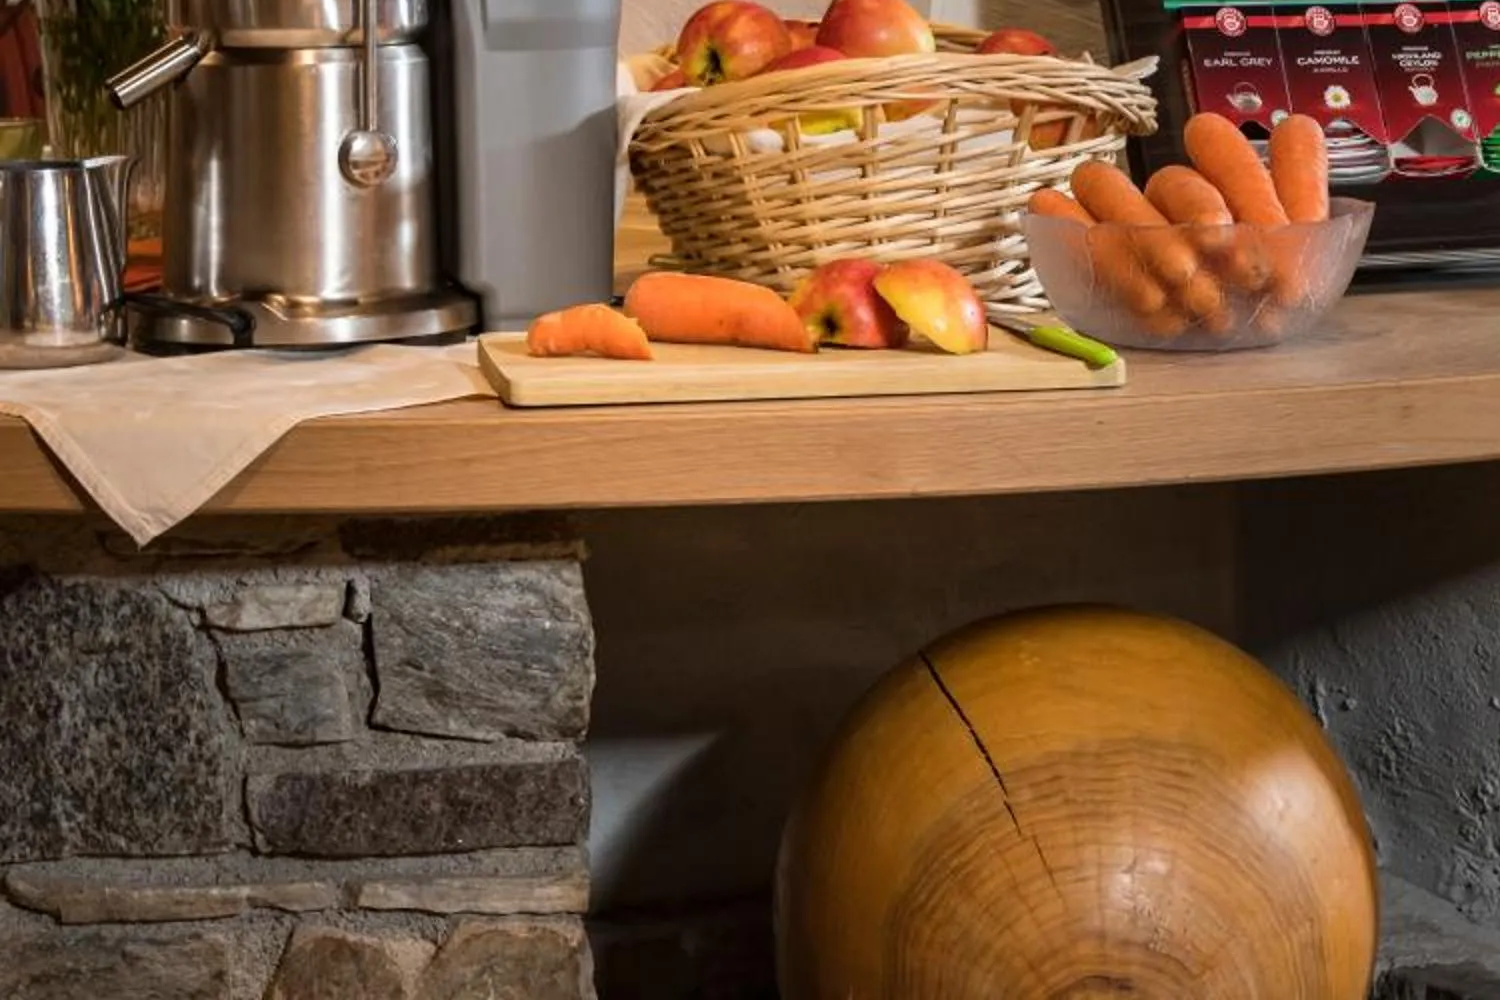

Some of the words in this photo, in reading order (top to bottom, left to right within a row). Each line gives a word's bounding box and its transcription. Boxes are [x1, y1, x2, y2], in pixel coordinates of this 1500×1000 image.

[1203, 57, 1238, 67] EARL
[1239, 57, 1273, 67] GREY
[1297, 55, 1360, 65] CAMOMILE
